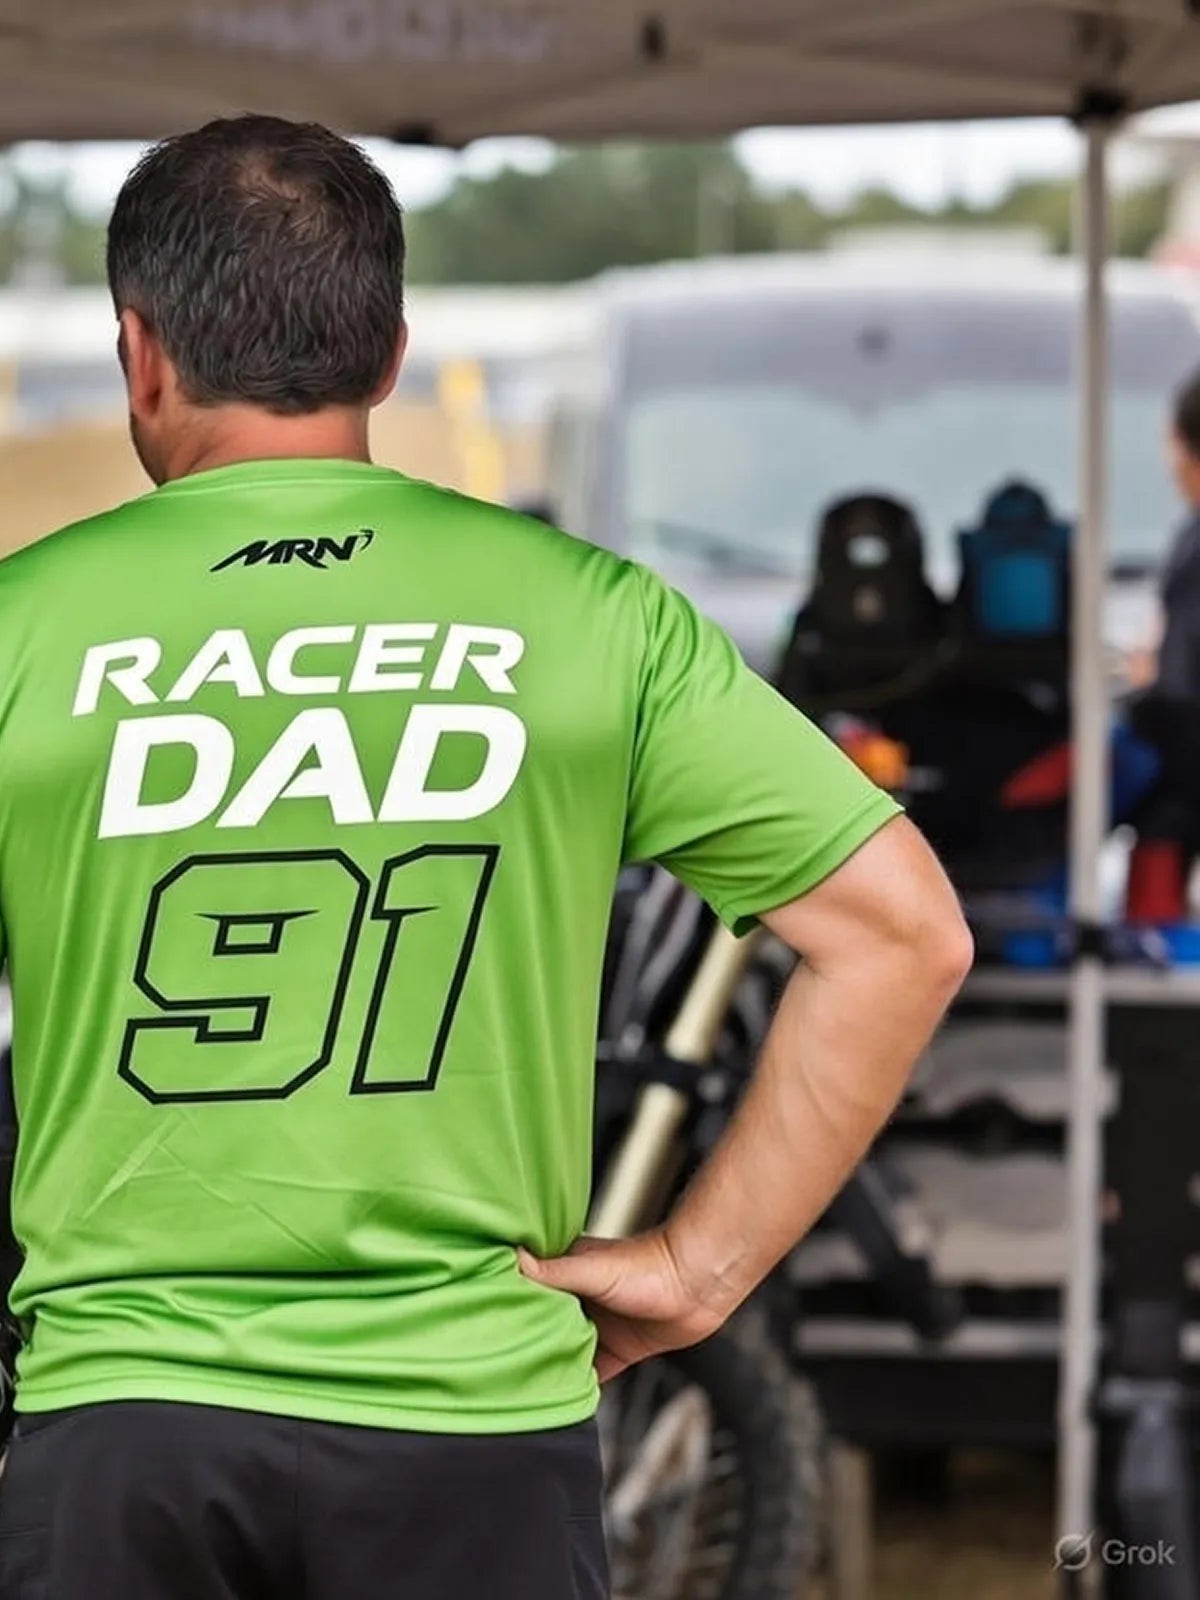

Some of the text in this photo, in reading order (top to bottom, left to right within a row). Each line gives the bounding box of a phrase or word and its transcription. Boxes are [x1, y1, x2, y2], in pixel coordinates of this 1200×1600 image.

[72, 622, 526, 717] RACER
[98, 703, 528, 840] DAD
[117, 844, 501, 1105] 91
